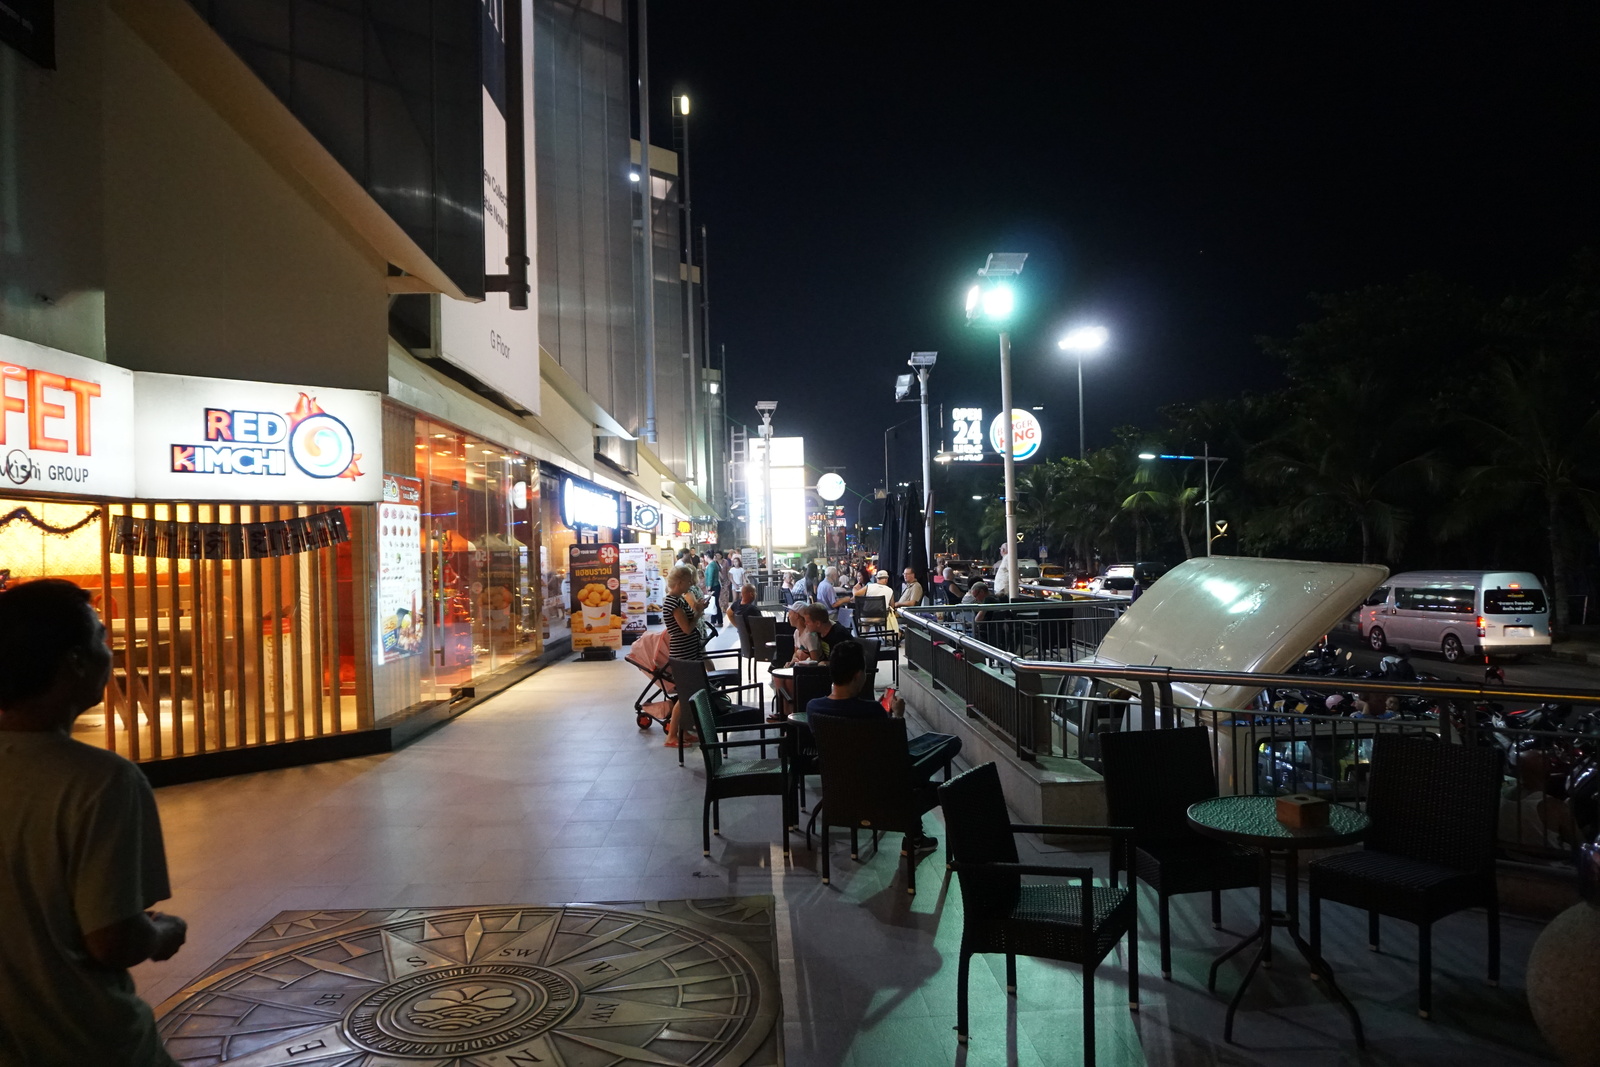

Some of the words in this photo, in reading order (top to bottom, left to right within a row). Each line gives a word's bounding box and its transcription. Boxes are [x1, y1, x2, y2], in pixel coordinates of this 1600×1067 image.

[490, 329, 496, 349] G
[496, 334, 511, 360] Floor
[204, 407, 287, 444] RED
[952, 420, 984, 445] 24
[170, 443, 287, 476] KIMCHI
[48, 464, 90, 483] GROUP
[406, 956, 428, 968] S
[499, 948, 539, 958] SW
[584, 961, 620, 976] W
[313, 993, 346, 1006] SE
[588, 1003, 620, 1024] NW
[286, 1039, 327, 1057] E
[505, 1047, 544, 1067] N
